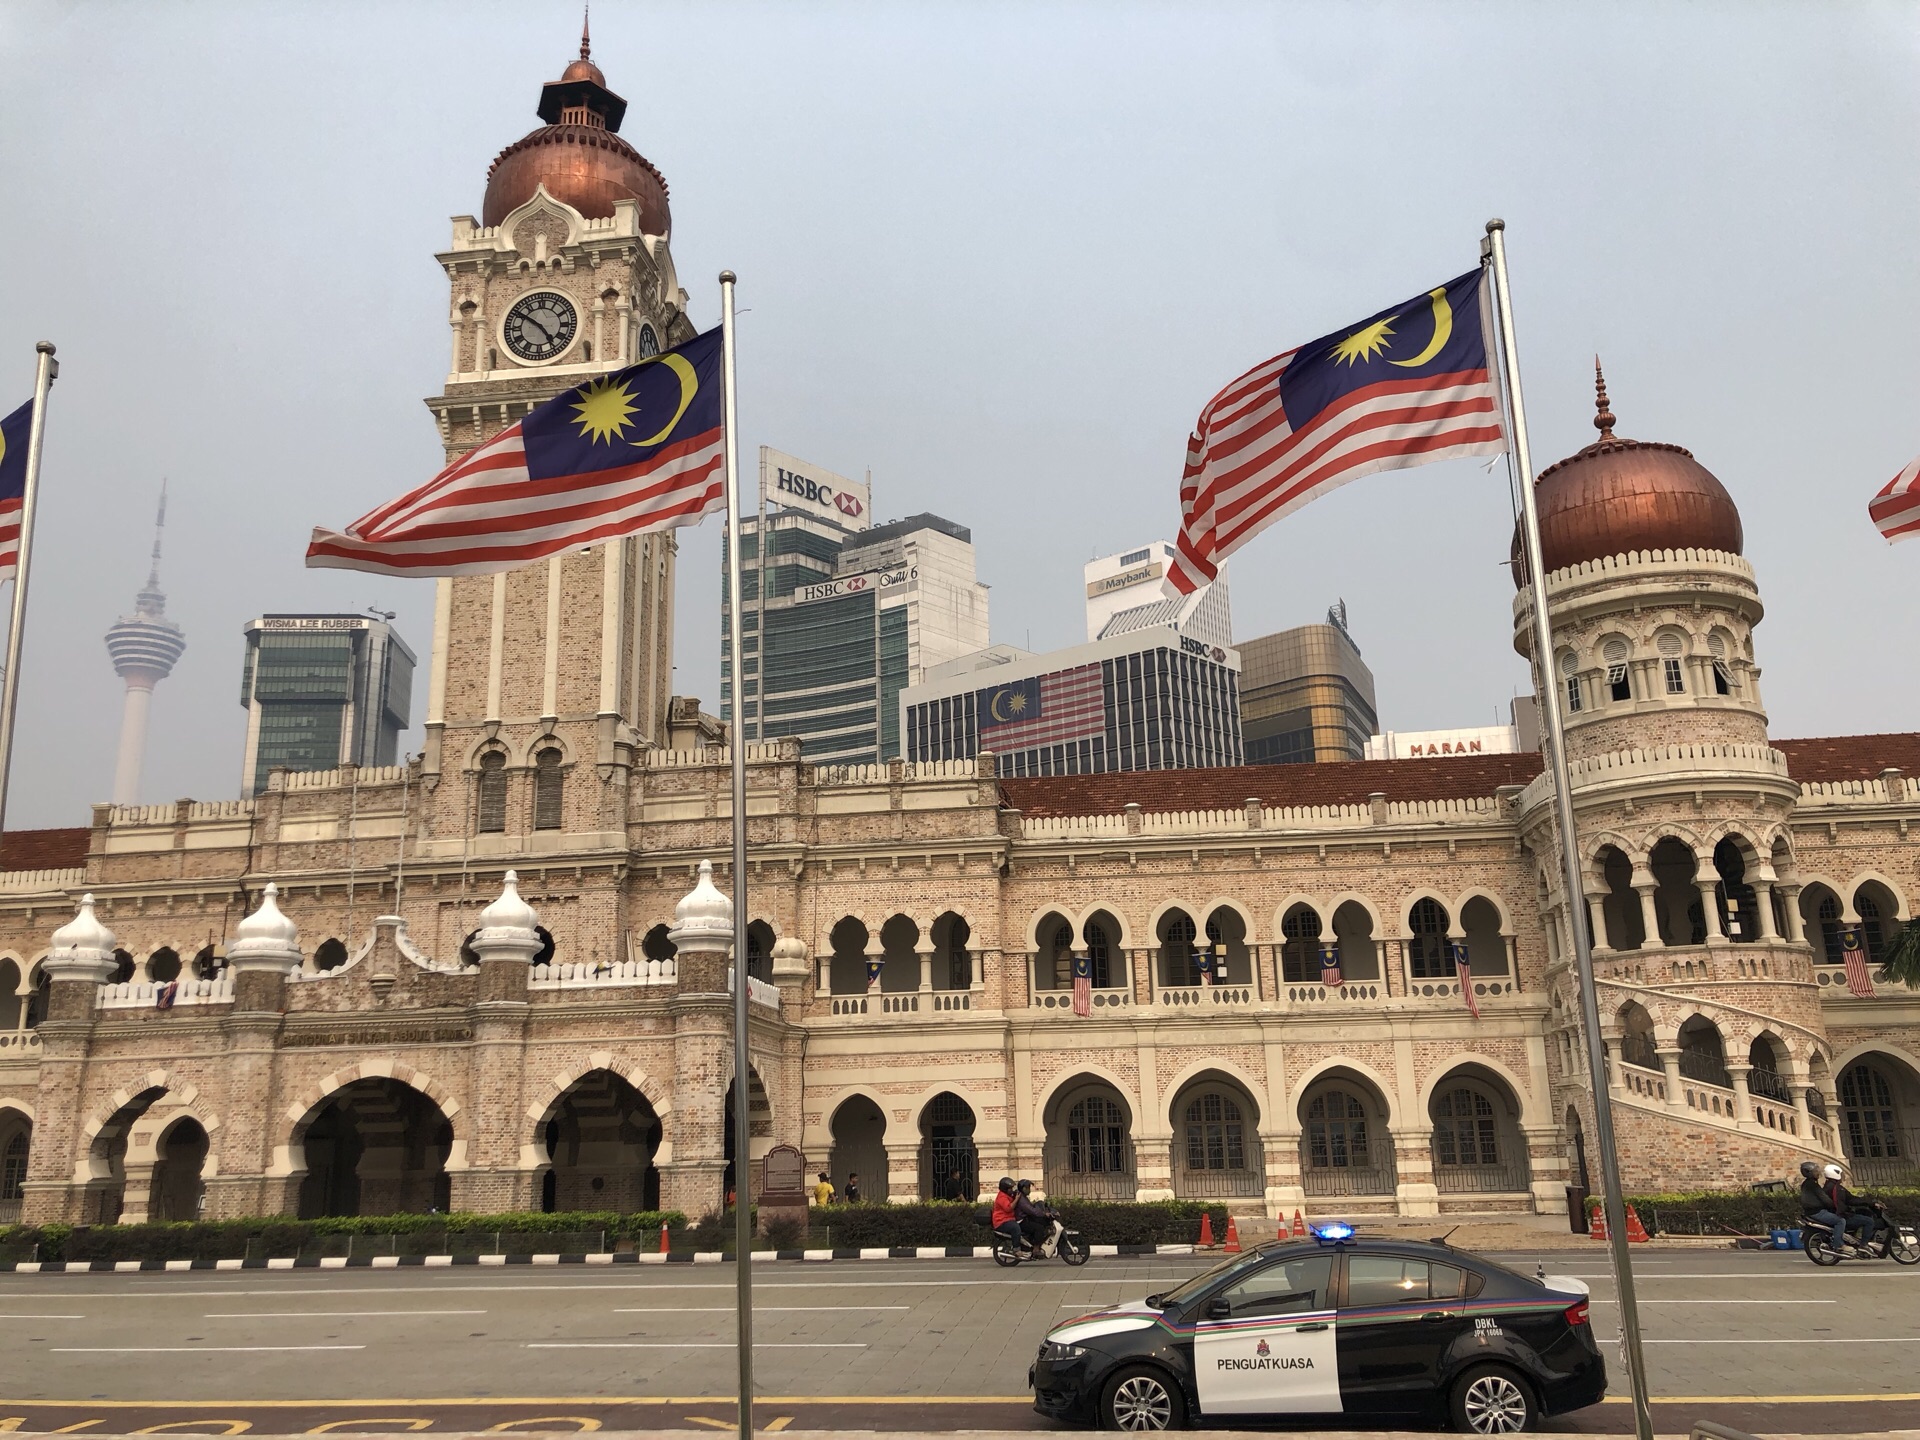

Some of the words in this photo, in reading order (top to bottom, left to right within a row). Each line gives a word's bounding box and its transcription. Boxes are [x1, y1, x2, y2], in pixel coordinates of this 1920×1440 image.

[777, 467, 832, 506] HSBC
[910, 565, 918, 579] 6
[1105, 568, 1151, 590] Maybank
[804, 580, 844, 601] HSBC
[263, 619, 298, 628] WISMA
[300, 619, 319, 628] LEE
[321, 619, 363, 628] RUBBER
[1179, 635, 1211, 658] HSBC
[1410, 740, 1482, 756] MARAN
[393, 1030, 430, 1042] ABDUL
[434, 1028, 472, 1041] SAMD
[1474, 1317, 1498, 1329] DBKL
[1474, 1329, 1486, 1337] JPK
[1217, 1357, 1315, 1370] PENGUATKUASA
